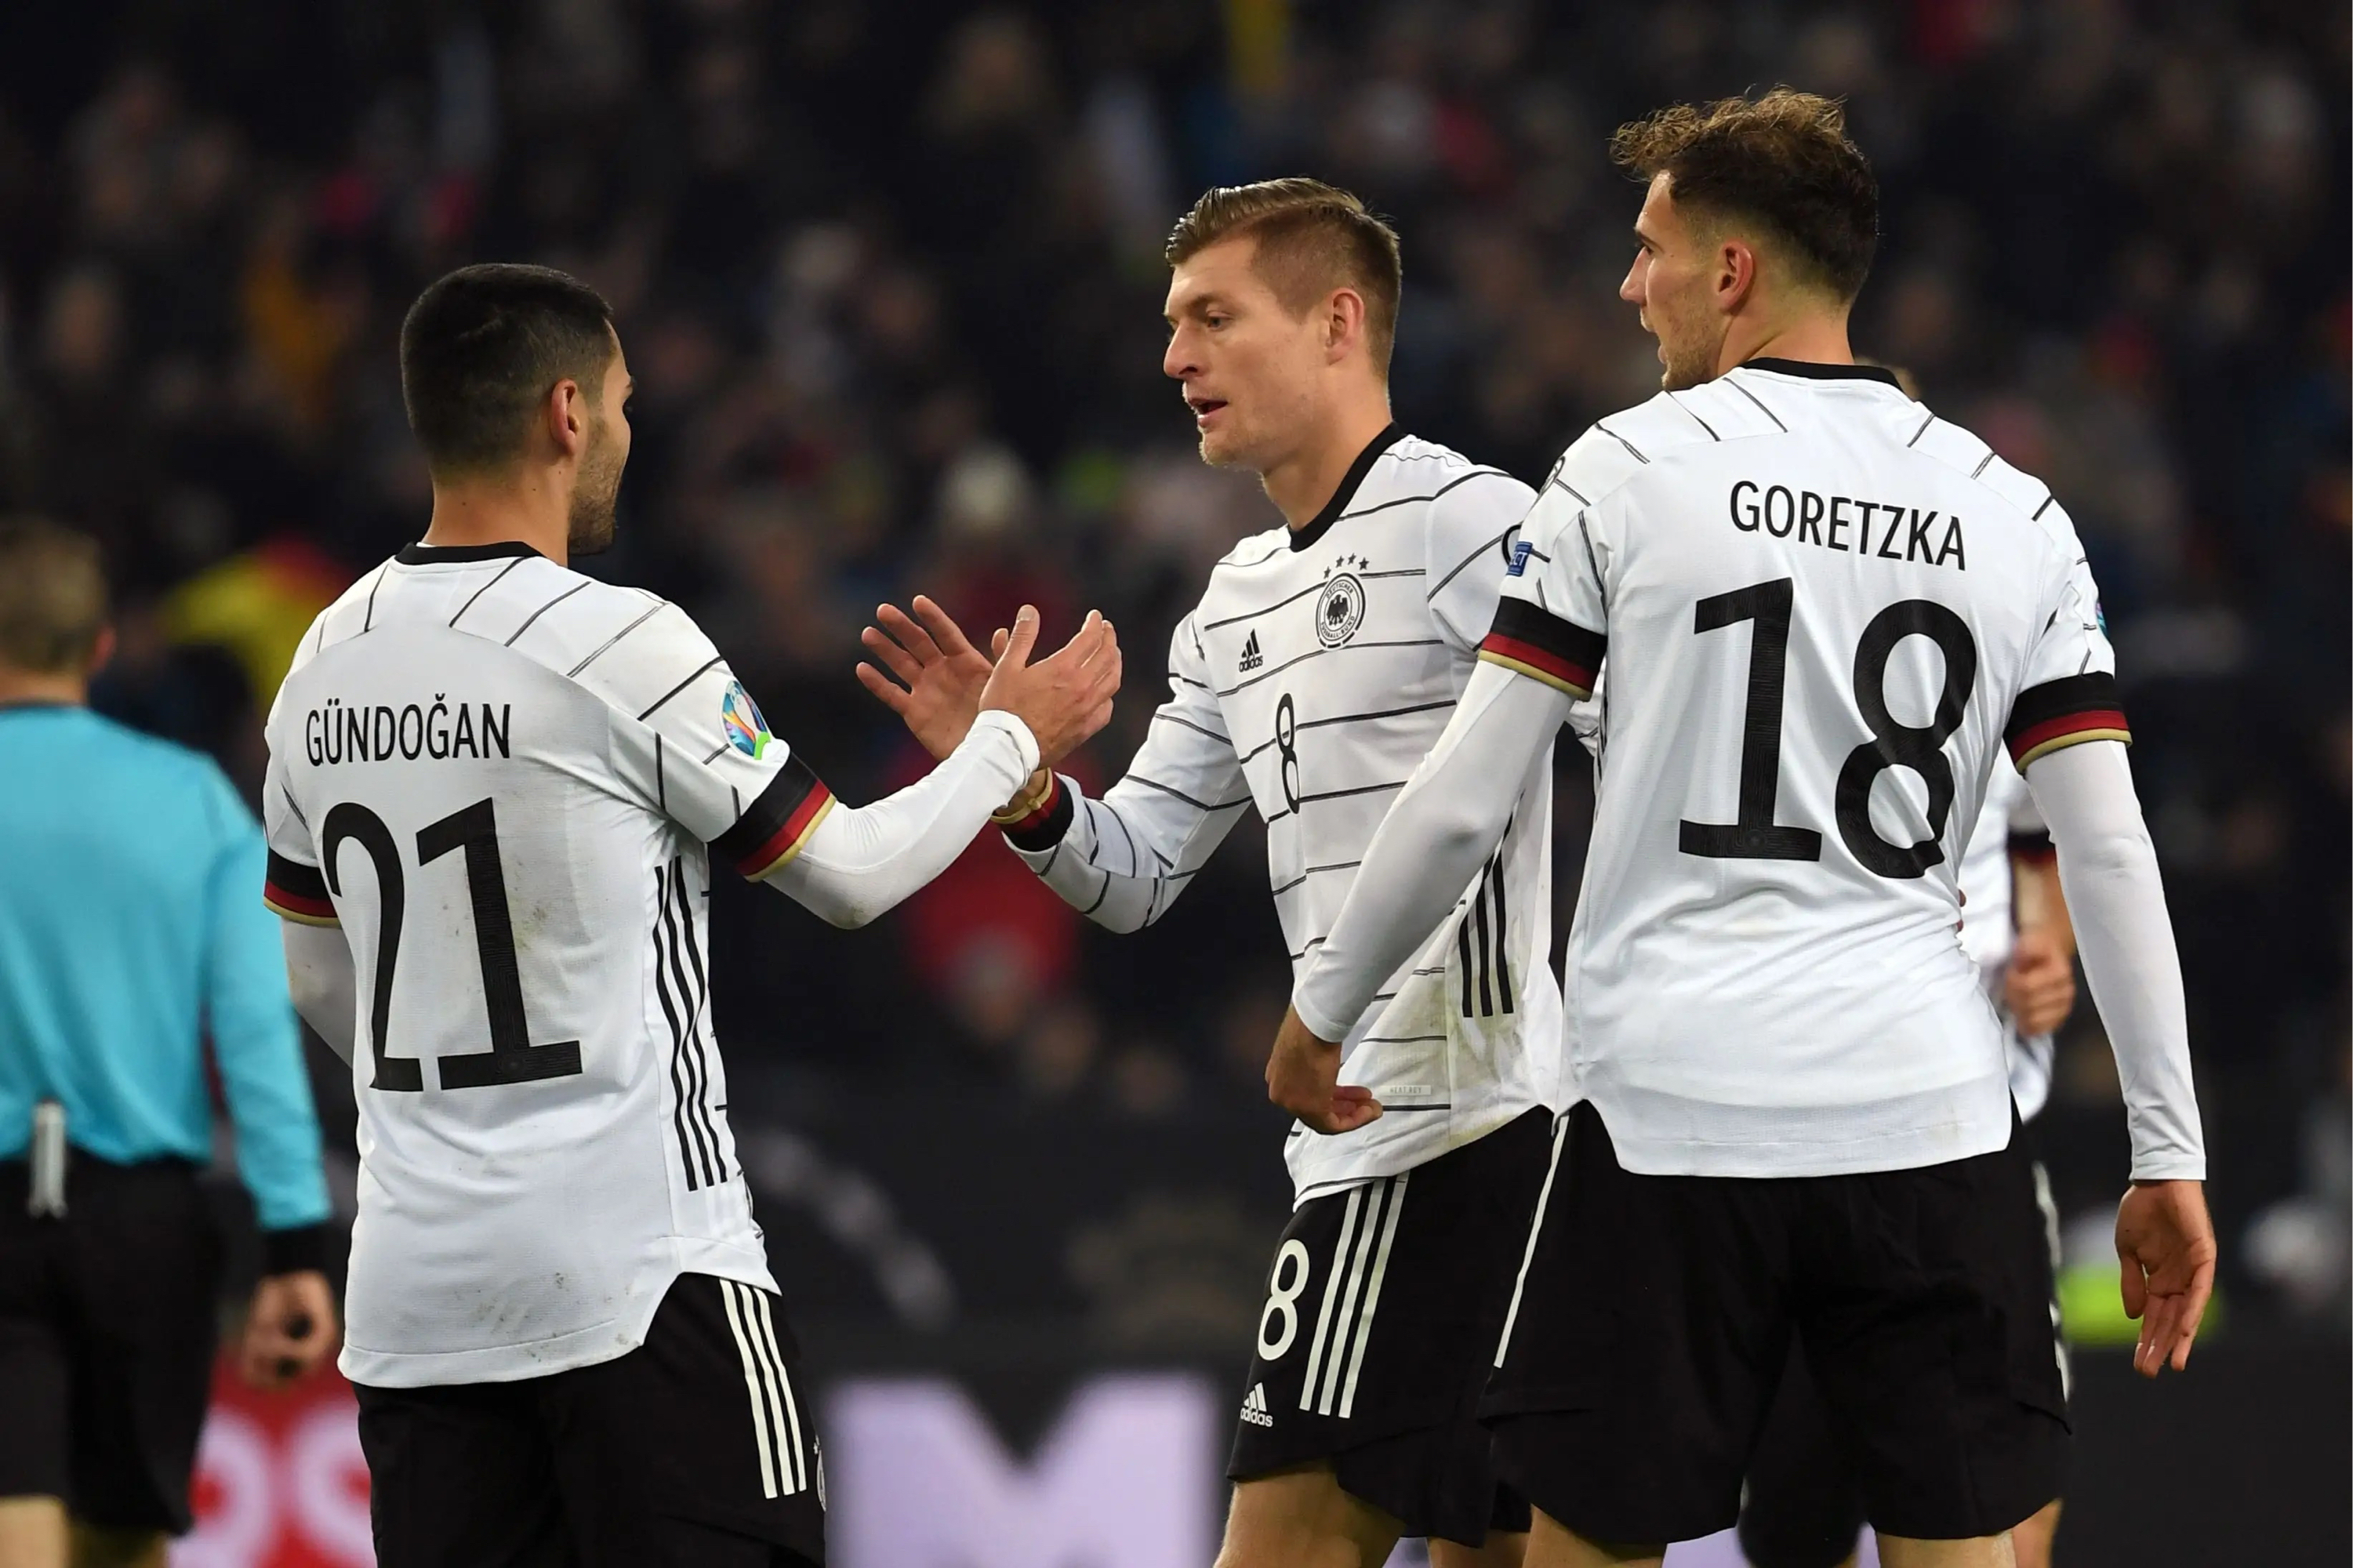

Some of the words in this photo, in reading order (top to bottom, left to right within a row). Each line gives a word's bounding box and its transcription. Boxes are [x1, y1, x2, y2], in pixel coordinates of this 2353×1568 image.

[1730, 481, 1965, 571] GORETZKA
[1239, 655, 1263, 673] adidas
[306, 693, 510, 767] GÜNDOĞAN
[1276, 693, 1300, 815] 8
[1679, 577, 1977, 880] 18
[322, 797, 583, 1092] 21
[1258, 1239, 1309, 1361] 8
[1240, 1406, 1273, 1428] adidas
